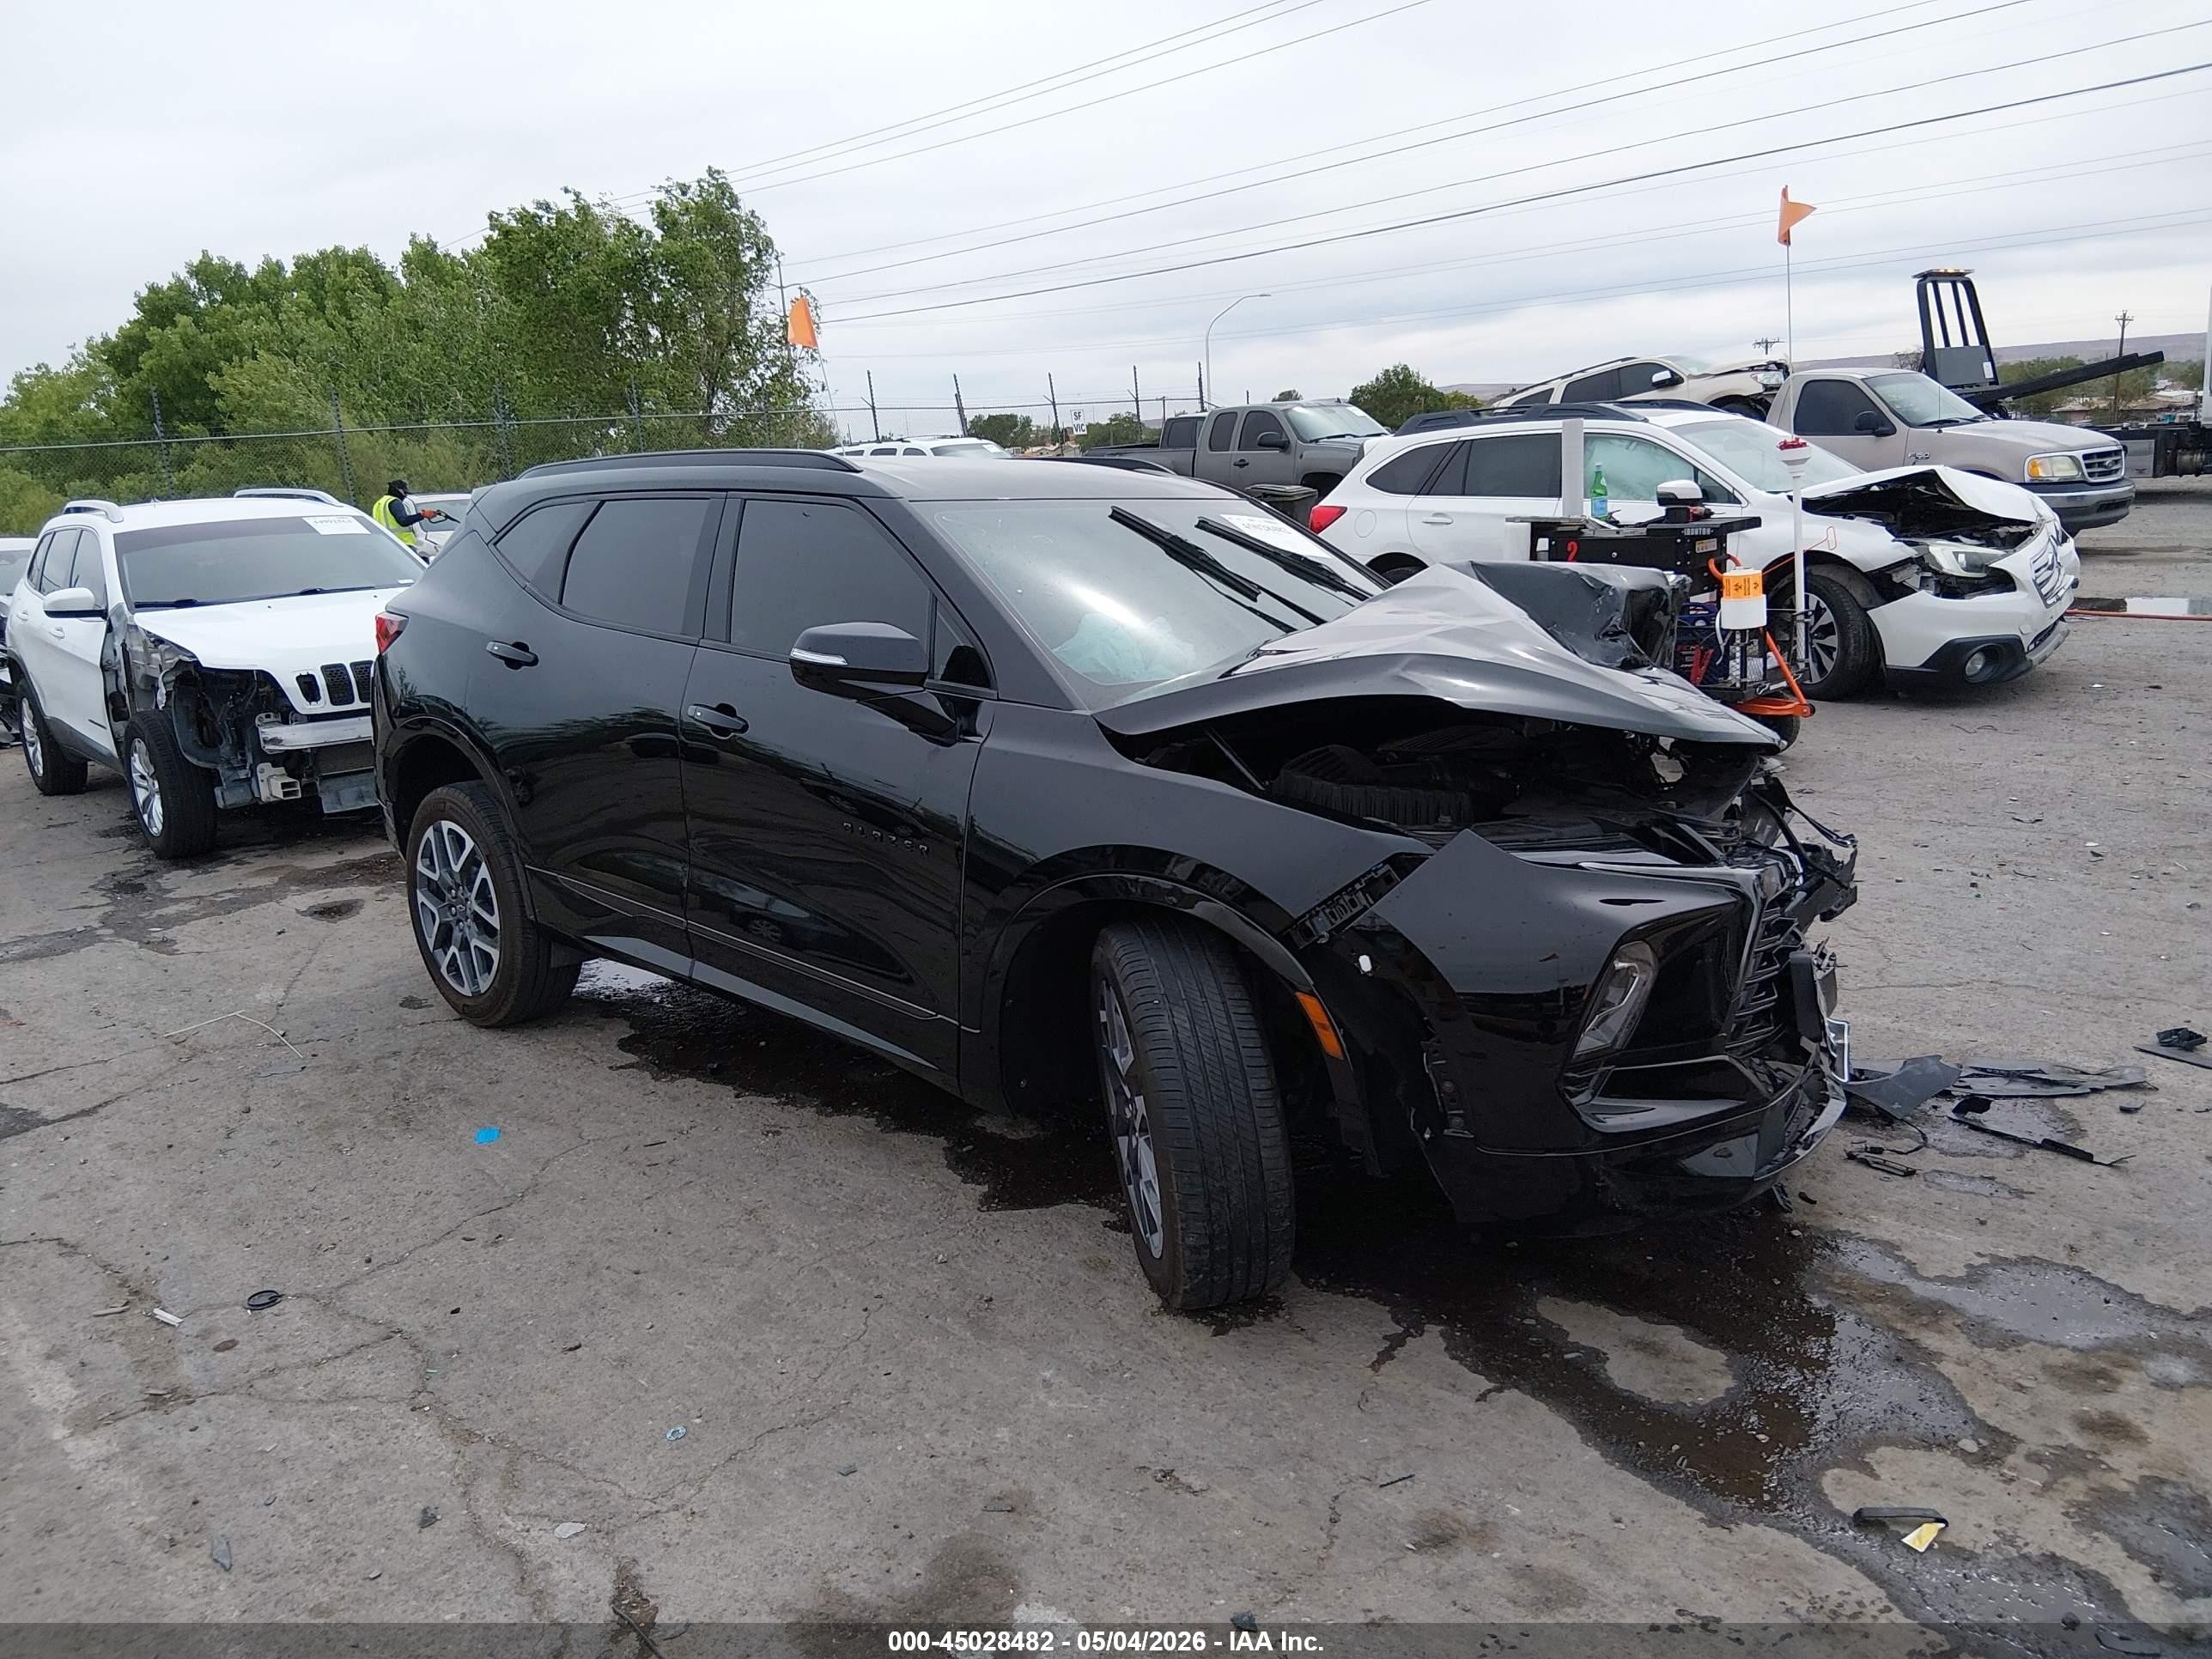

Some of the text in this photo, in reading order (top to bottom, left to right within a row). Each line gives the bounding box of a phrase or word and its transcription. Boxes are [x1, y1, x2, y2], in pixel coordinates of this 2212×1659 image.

[1073, 411, 1082, 421] SF
[1073, 423, 1085, 433] VIC
[1566, 540, 1578, 563] 2
[842, 822, 929, 858] BLAZER
